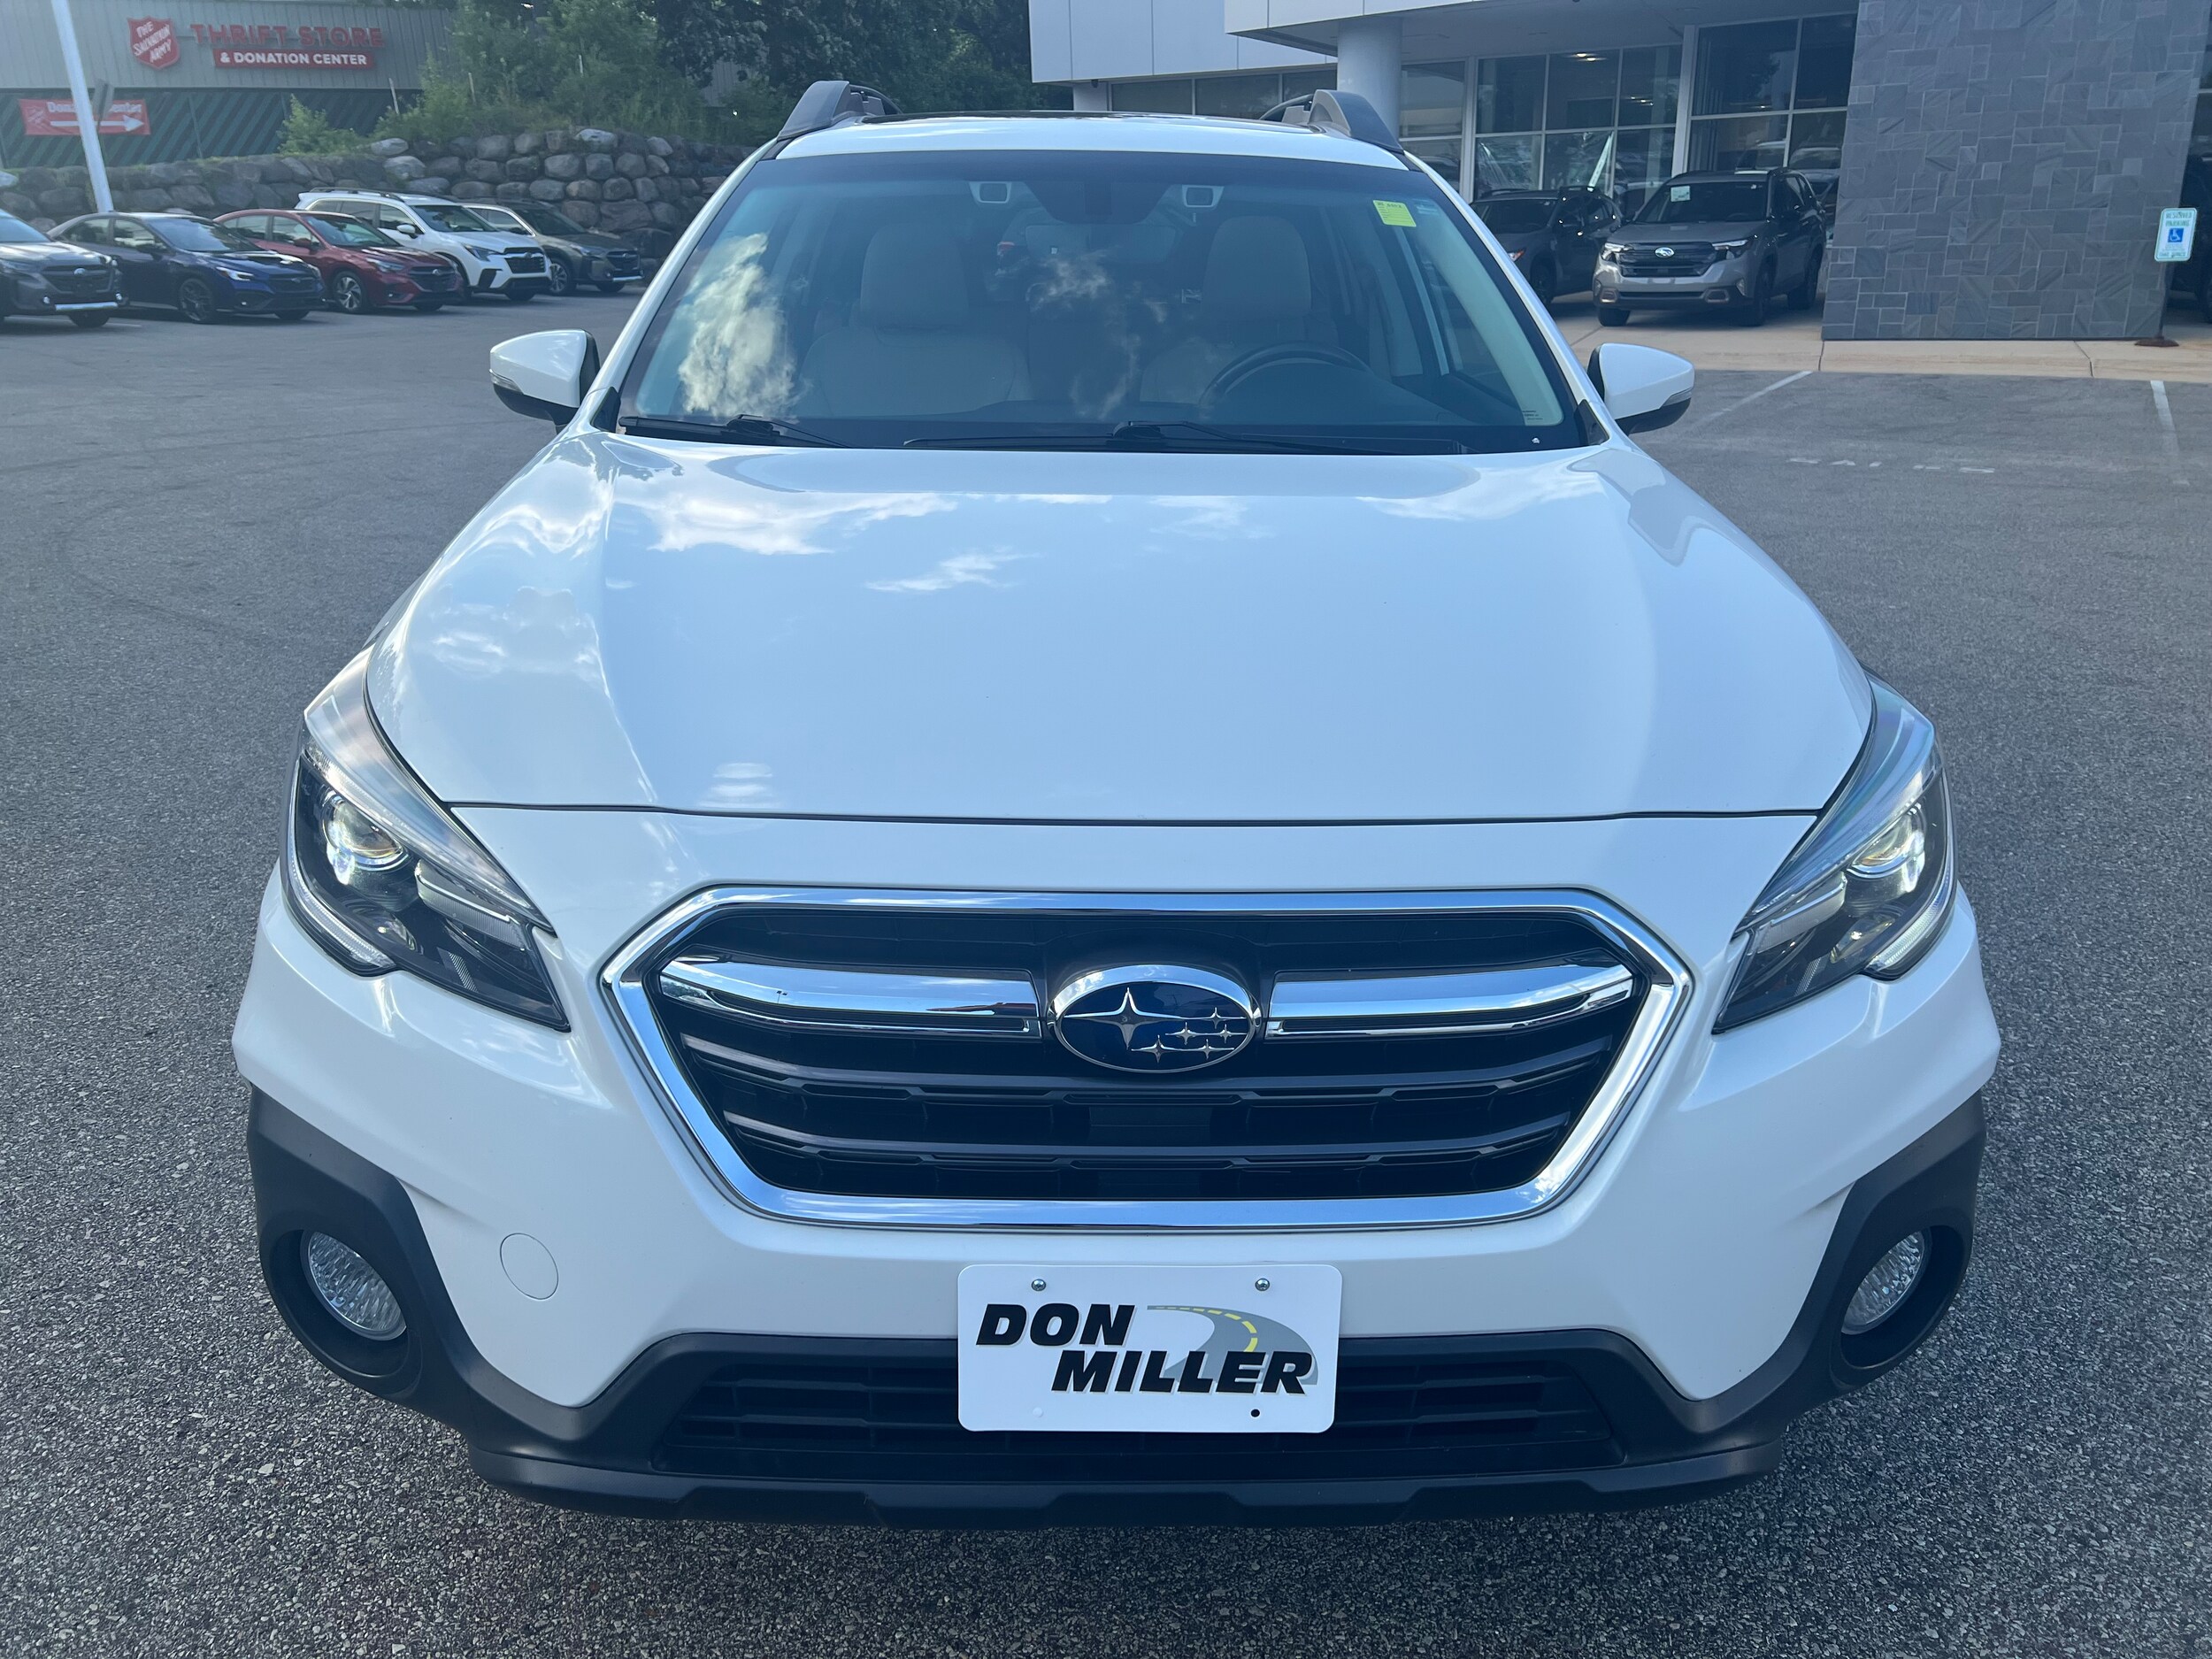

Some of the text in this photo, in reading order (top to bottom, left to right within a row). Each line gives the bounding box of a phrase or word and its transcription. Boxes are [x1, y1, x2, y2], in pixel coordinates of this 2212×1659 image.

[190, 24, 385, 47] THRIFT STORE
[220, 52, 367, 65] & DONATION CENTER
[976, 1303, 1135, 1347] DON
[1051, 1350, 1312, 1394] MILLER
